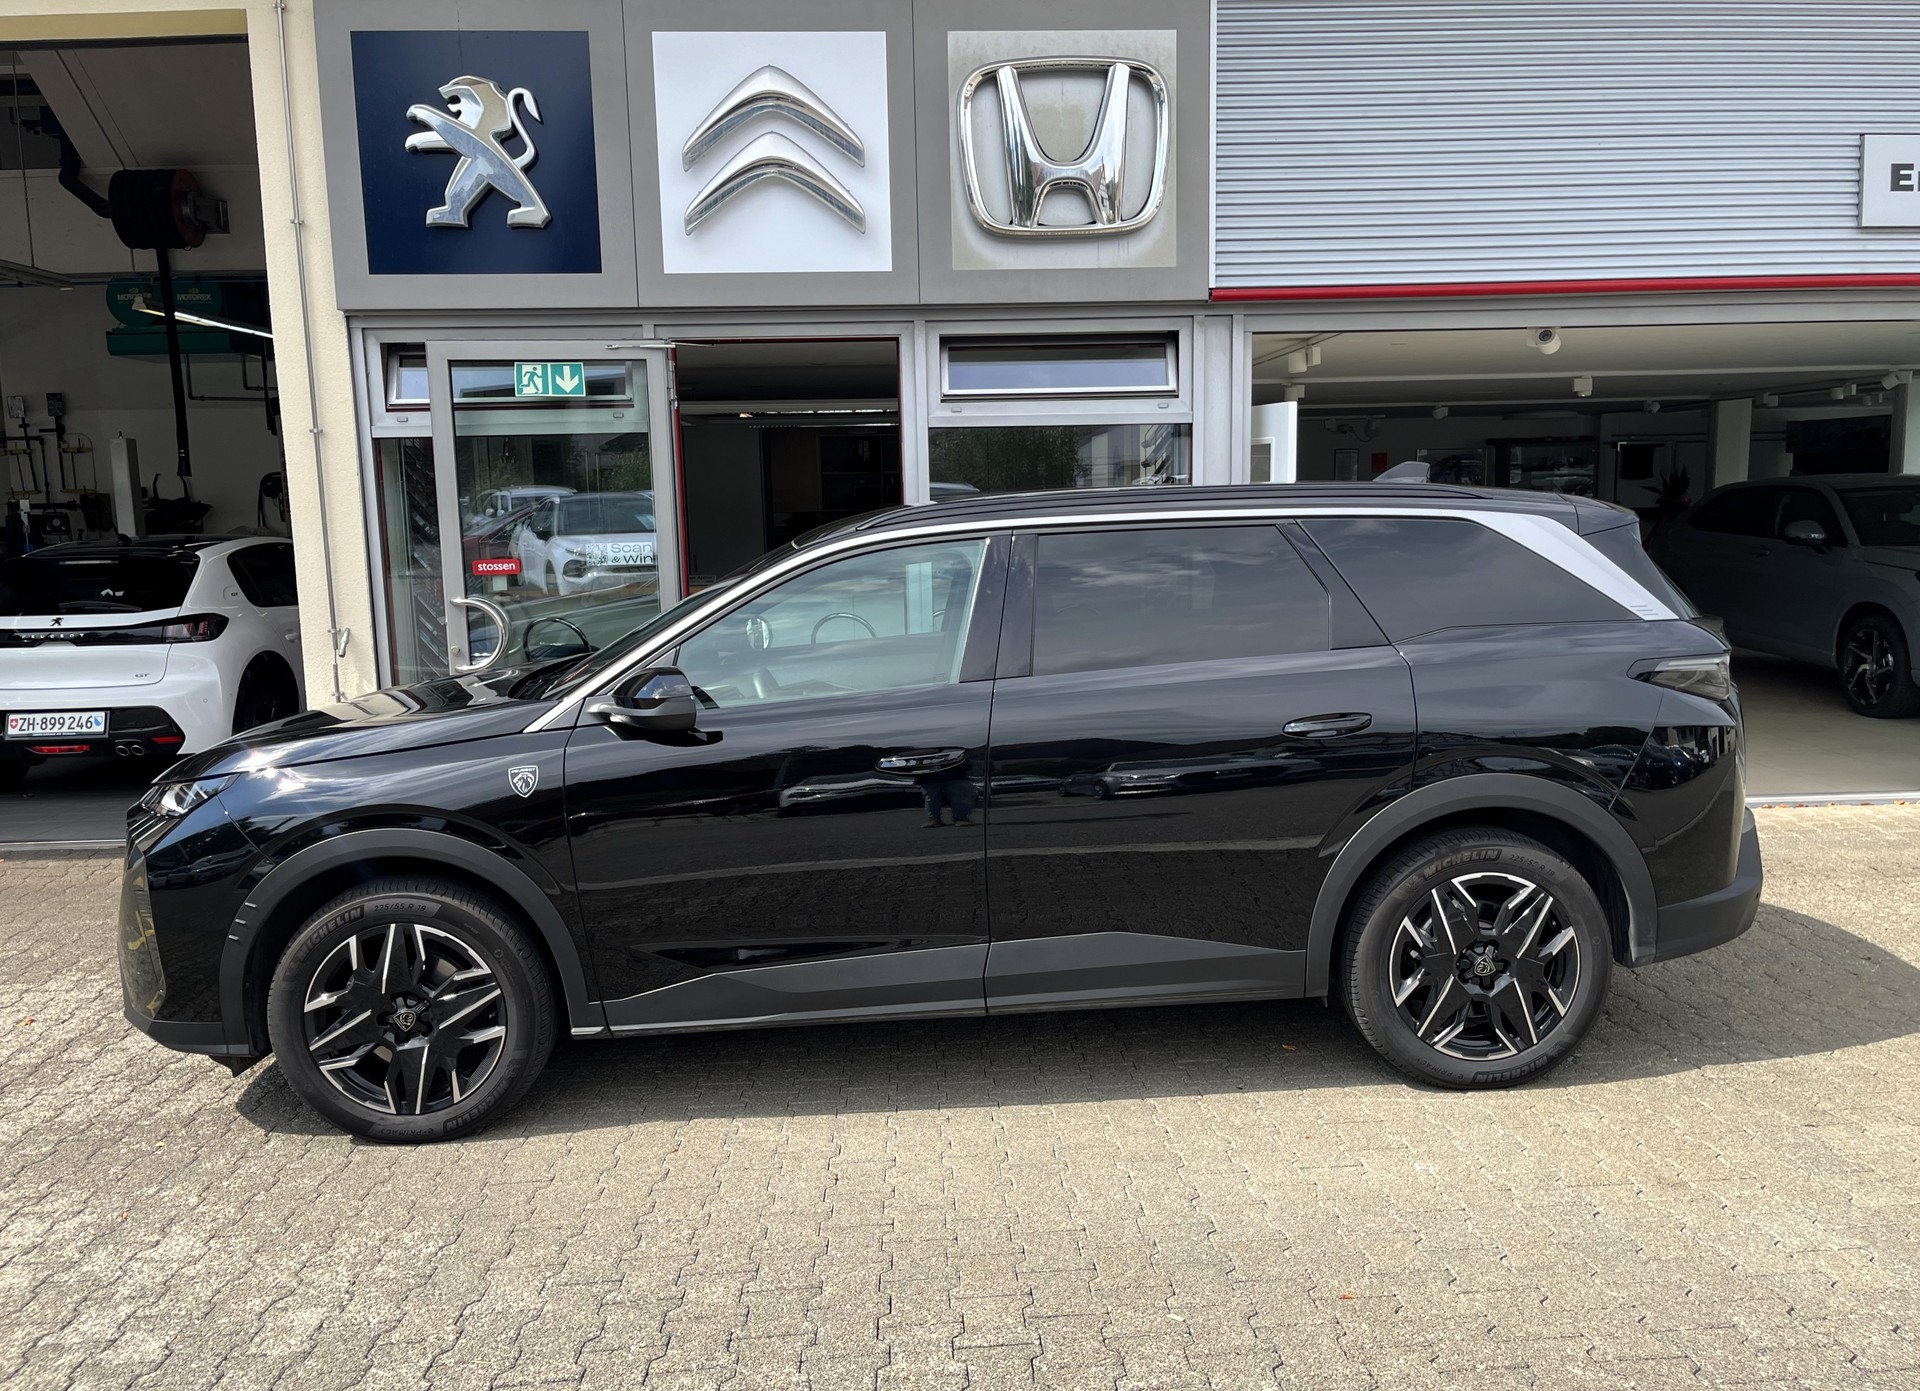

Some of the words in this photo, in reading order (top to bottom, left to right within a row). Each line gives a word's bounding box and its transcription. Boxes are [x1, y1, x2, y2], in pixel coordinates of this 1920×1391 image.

[1890, 162, 1920, 192] E
[611, 543, 653, 554] Scan
[477, 562, 516, 572] stossen
[611, 555, 621, 564] &
[623, 553, 654, 564] Win
[1423, 849, 1500, 879] MICHELIN
[374, 903, 405, 912] 225/55
[417, 904, 427, 912] 19
[297, 906, 362, 959] MICHELIN
[1474, 1055, 1548, 1083] MICHELIN
